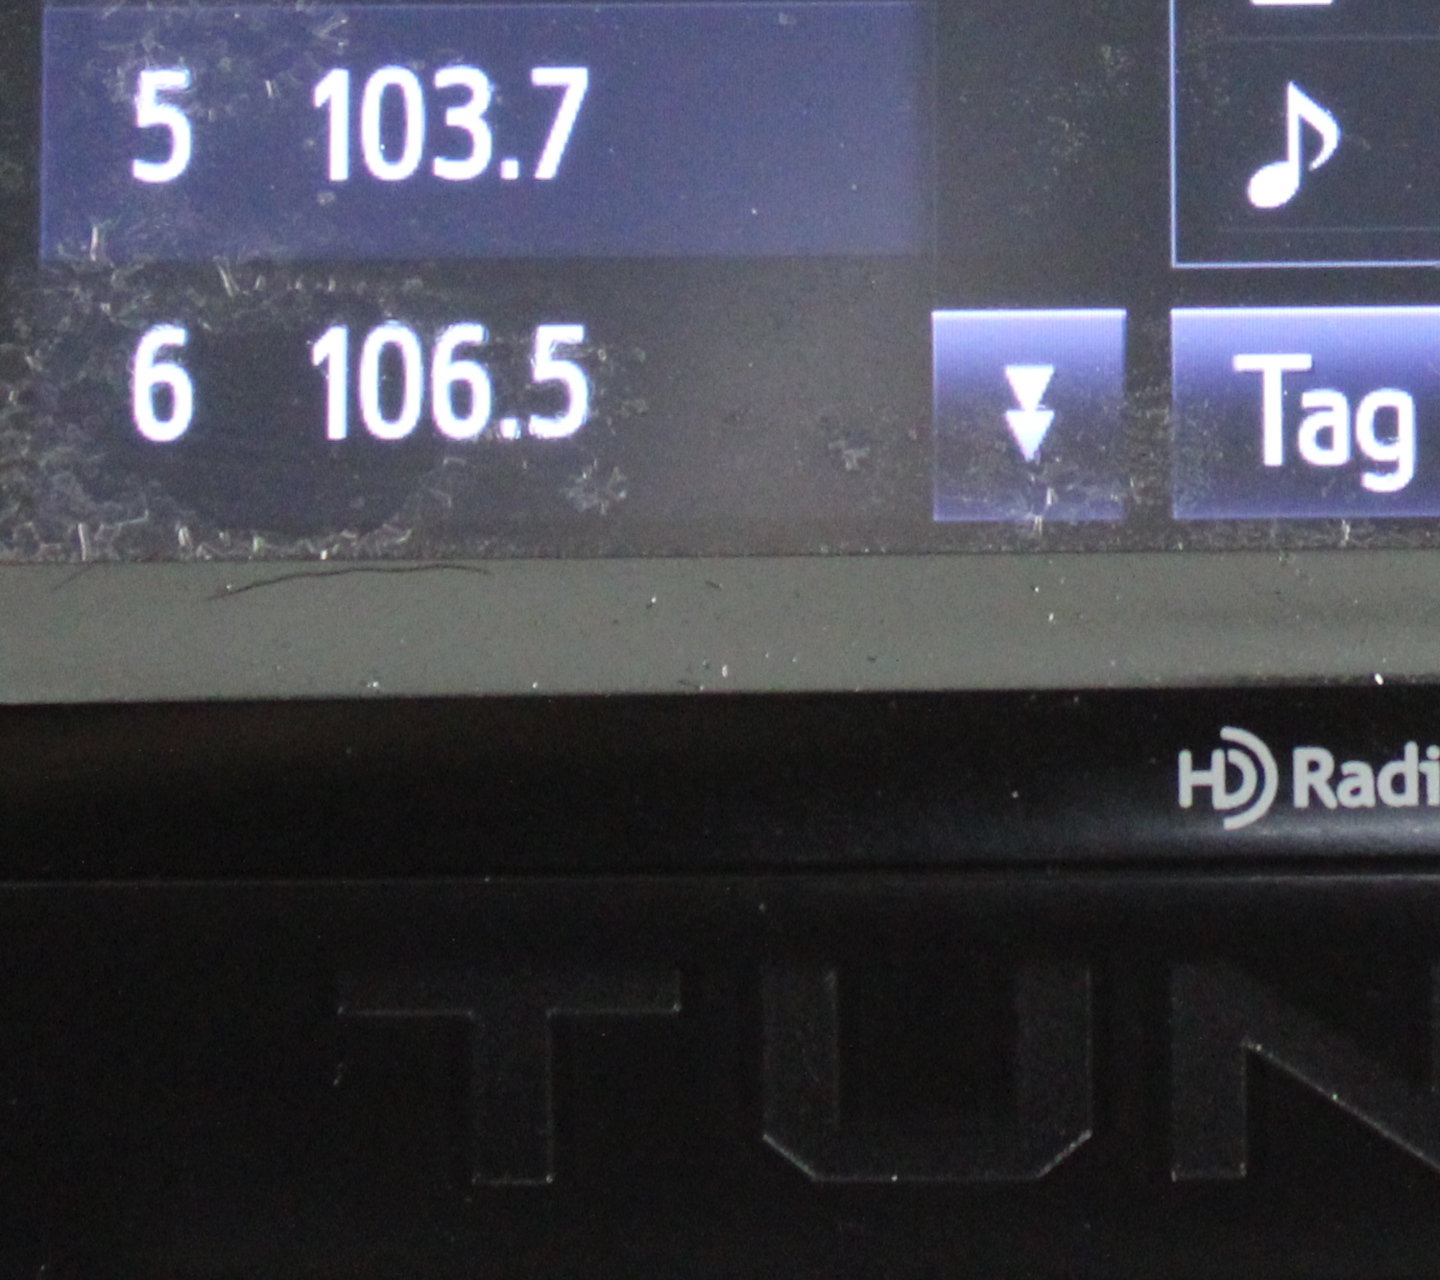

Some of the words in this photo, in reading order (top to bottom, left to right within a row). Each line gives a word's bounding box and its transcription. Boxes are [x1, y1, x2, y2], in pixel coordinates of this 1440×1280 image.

[132, 68, 192, 184] 5
[313, 64, 589, 182] 103.7
[132, 323, 194, 442] 6
[312, 322, 589, 441] 106.5
[1233, 352, 1415, 493] Tag
